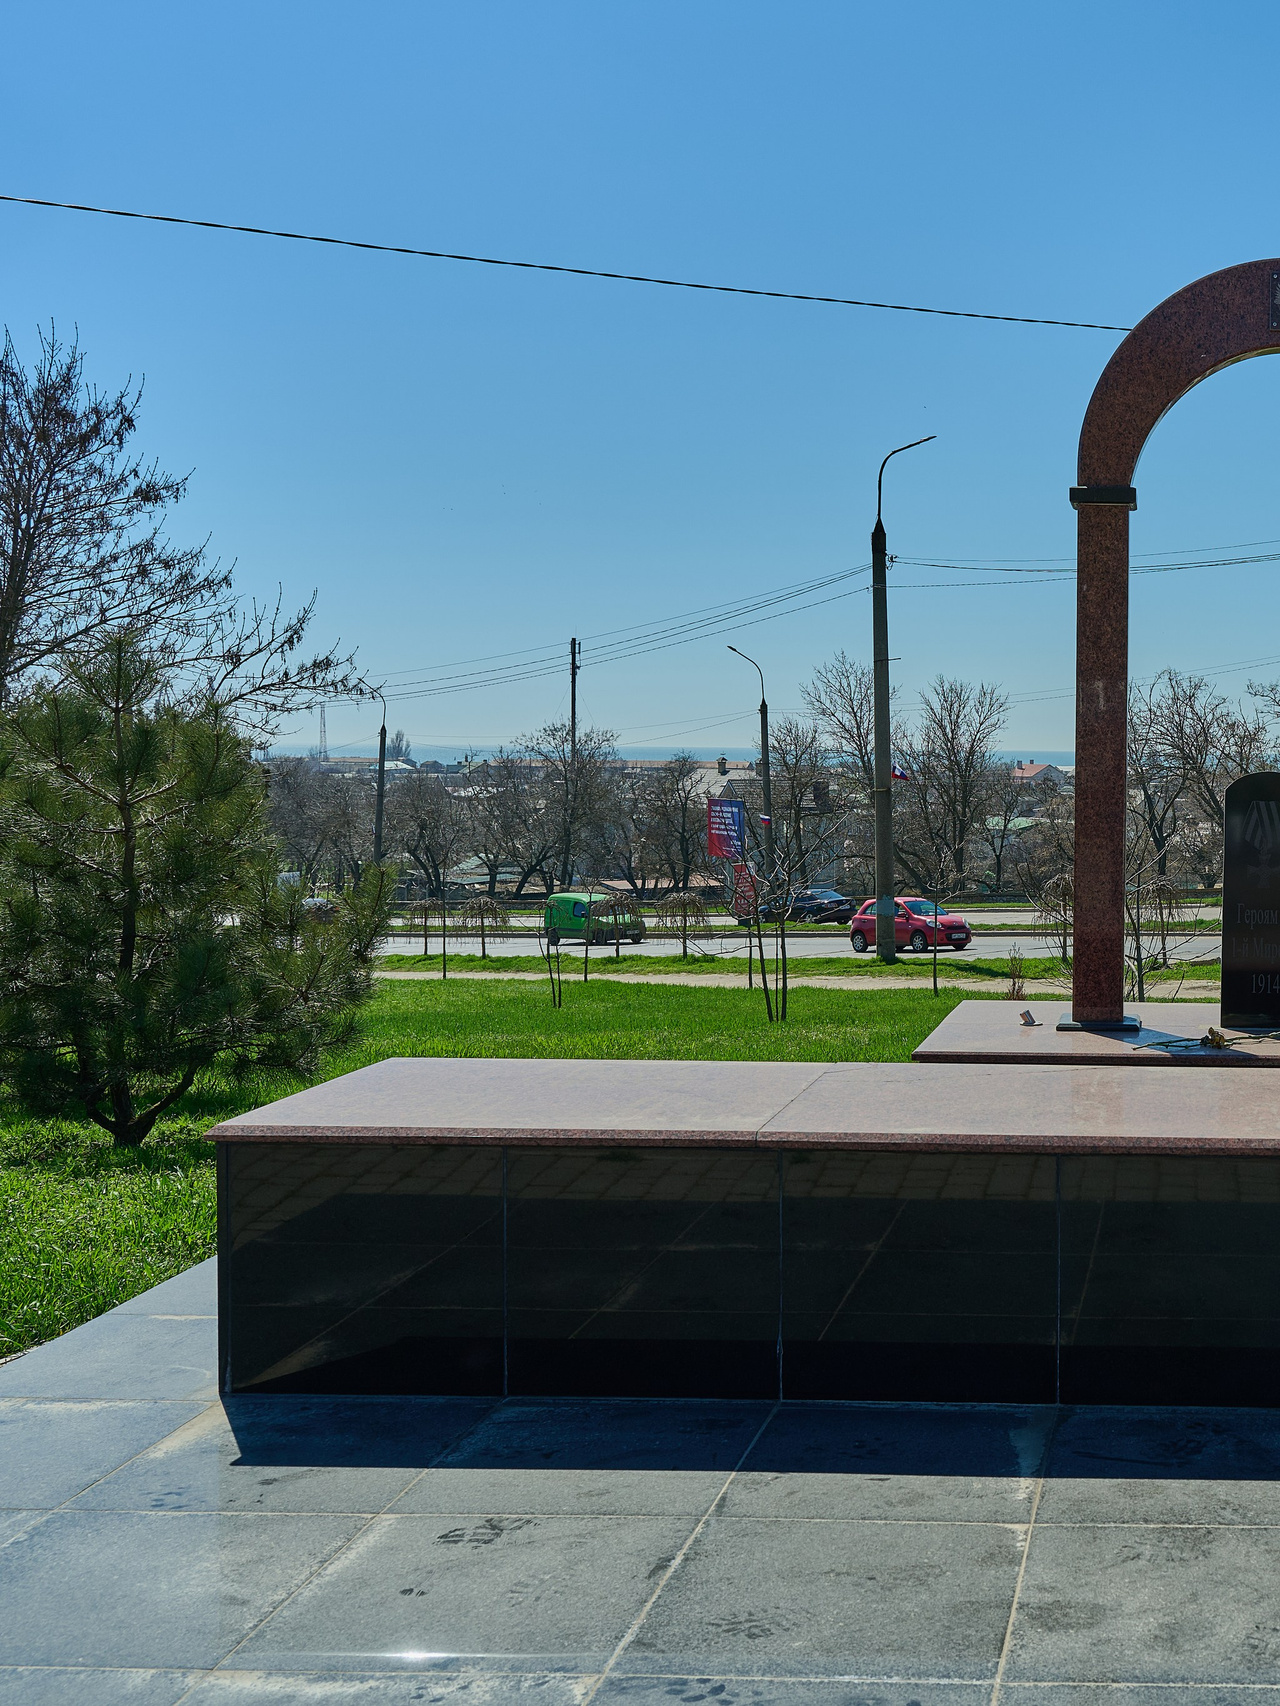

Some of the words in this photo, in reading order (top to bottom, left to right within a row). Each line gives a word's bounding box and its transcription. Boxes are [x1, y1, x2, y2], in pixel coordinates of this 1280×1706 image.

[1236, 903, 1278, 930] Героям
[1232, 937, 1249, 958] 1-й
[1251, 973, 1280, 994] 1914
